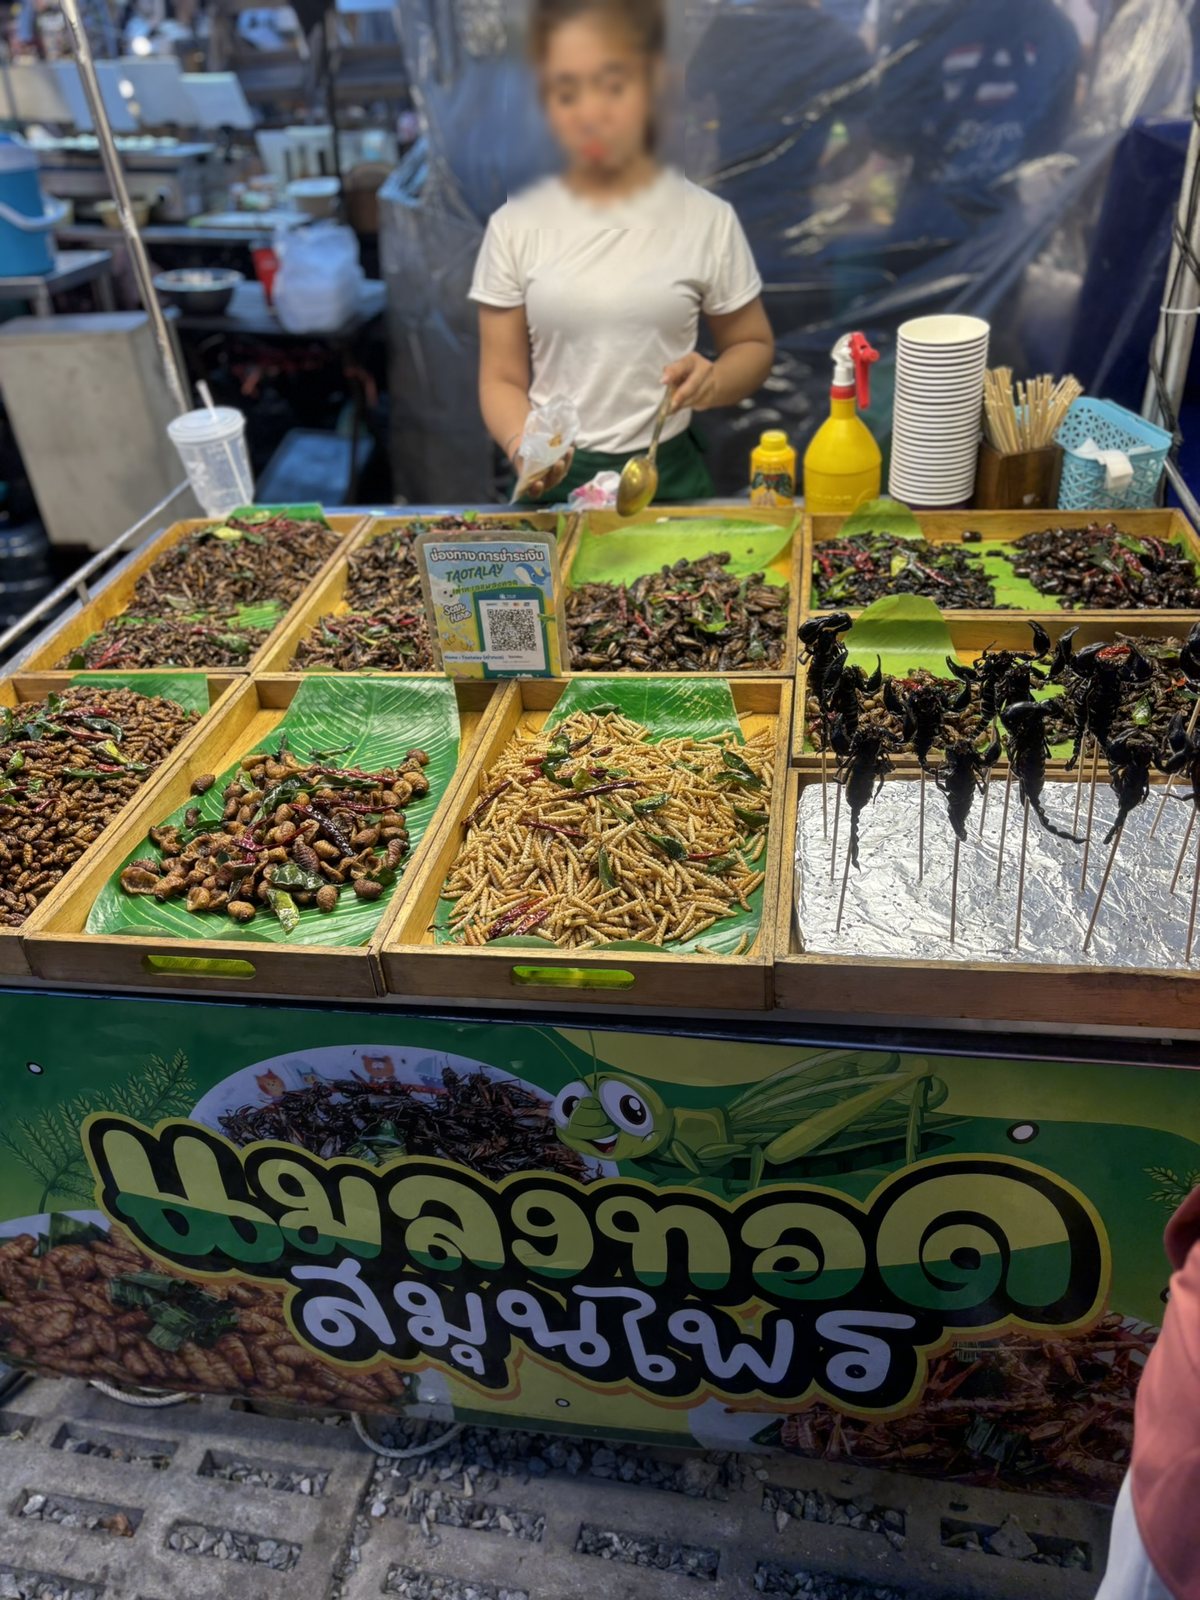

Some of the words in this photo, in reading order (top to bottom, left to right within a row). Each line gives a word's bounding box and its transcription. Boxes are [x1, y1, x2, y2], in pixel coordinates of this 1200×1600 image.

[431, 548, 476, 562] ช่องทาง
[478, 548, 544, 561] การชำระเงิน
[446, 564, 504, 582] TAOTALAY
[444, 603, 465, 616] Scan
[101, 1128, 1073, 1309] แมลงทอด
[291, 1257, 916, 1393] สมุนไพร
